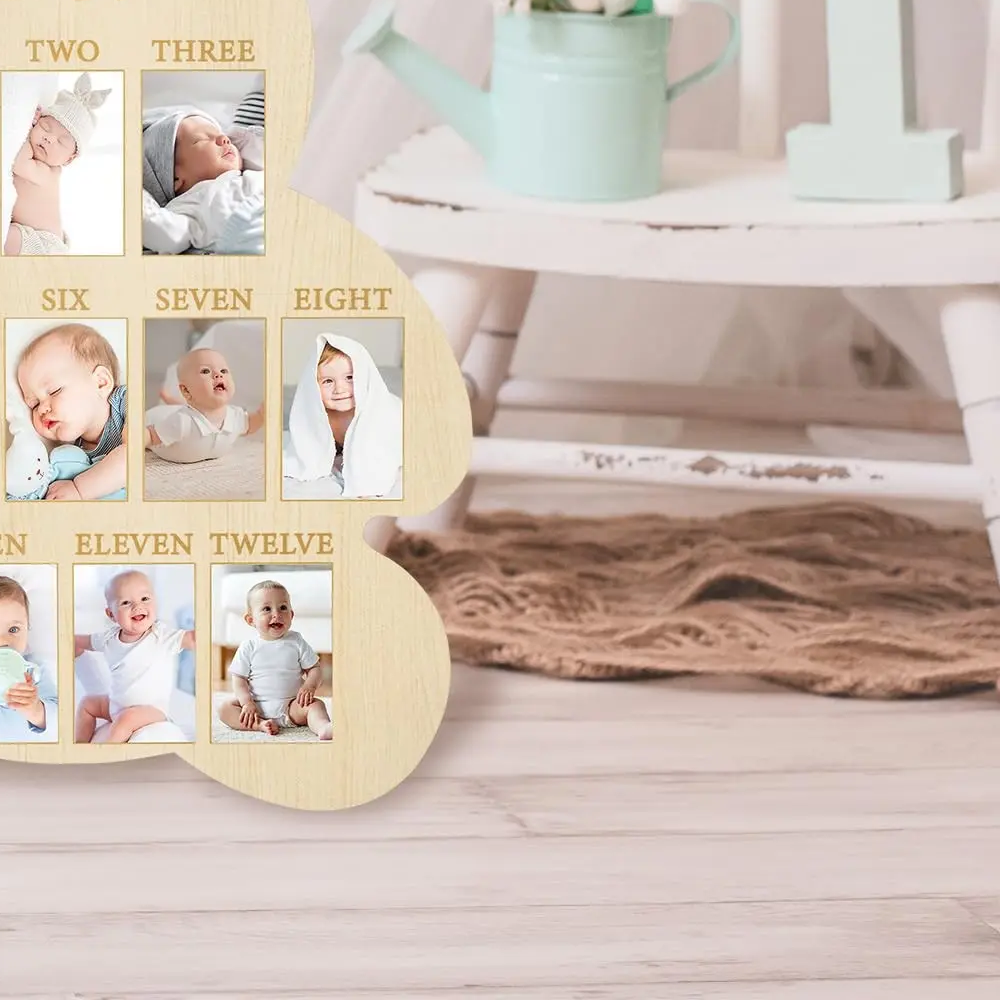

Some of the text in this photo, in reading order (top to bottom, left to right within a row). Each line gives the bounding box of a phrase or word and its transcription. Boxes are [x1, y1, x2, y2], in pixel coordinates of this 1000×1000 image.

[26, 40, 100, 62] TWO
[152, 40, 254, 62] THREE
[42, 288, 89, 311] SIX
[157, 288, 253, 311] SEVEN
[295, 288, 391, 311] EIGHT
[75, 533, 192, 555] ELEVEN
[210, 532, 333, 555] TWELVE
